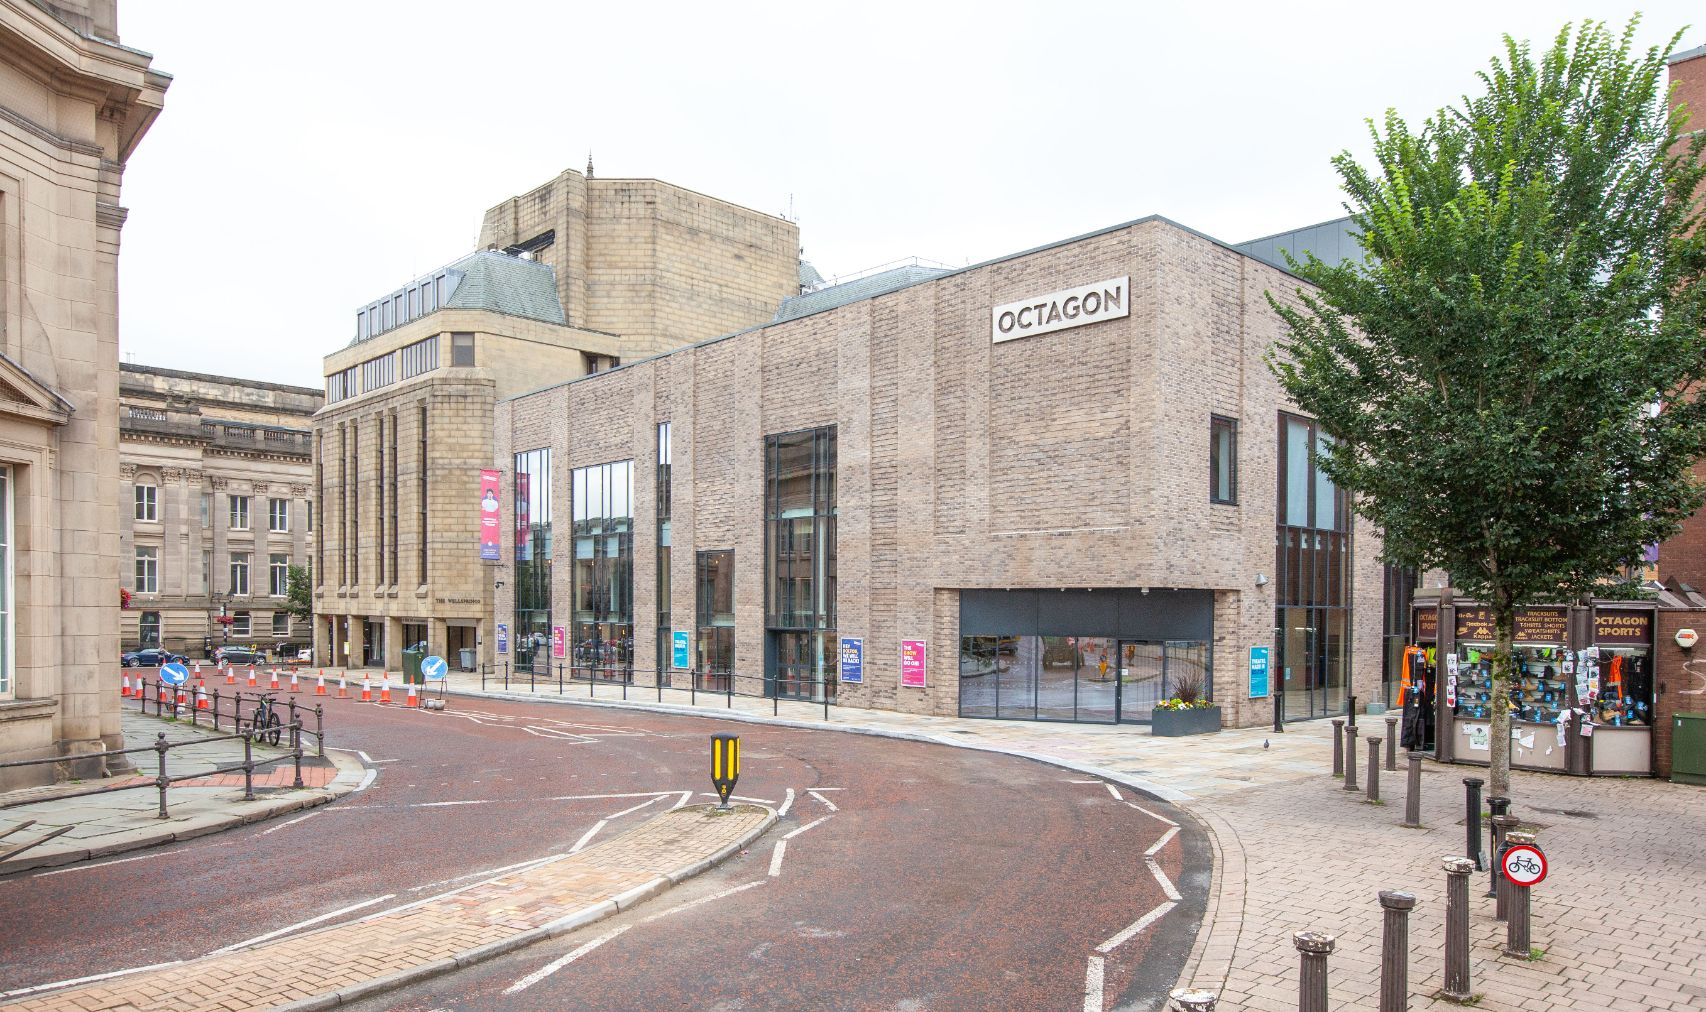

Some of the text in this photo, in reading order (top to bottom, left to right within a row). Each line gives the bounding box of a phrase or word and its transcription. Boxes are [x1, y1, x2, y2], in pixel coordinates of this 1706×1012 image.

[998, 286, 1121, 334] OCTAGON
[1595, 617, 1648, 625] OCTAGON
[1598, 628, 1641, 636] SPORTS
